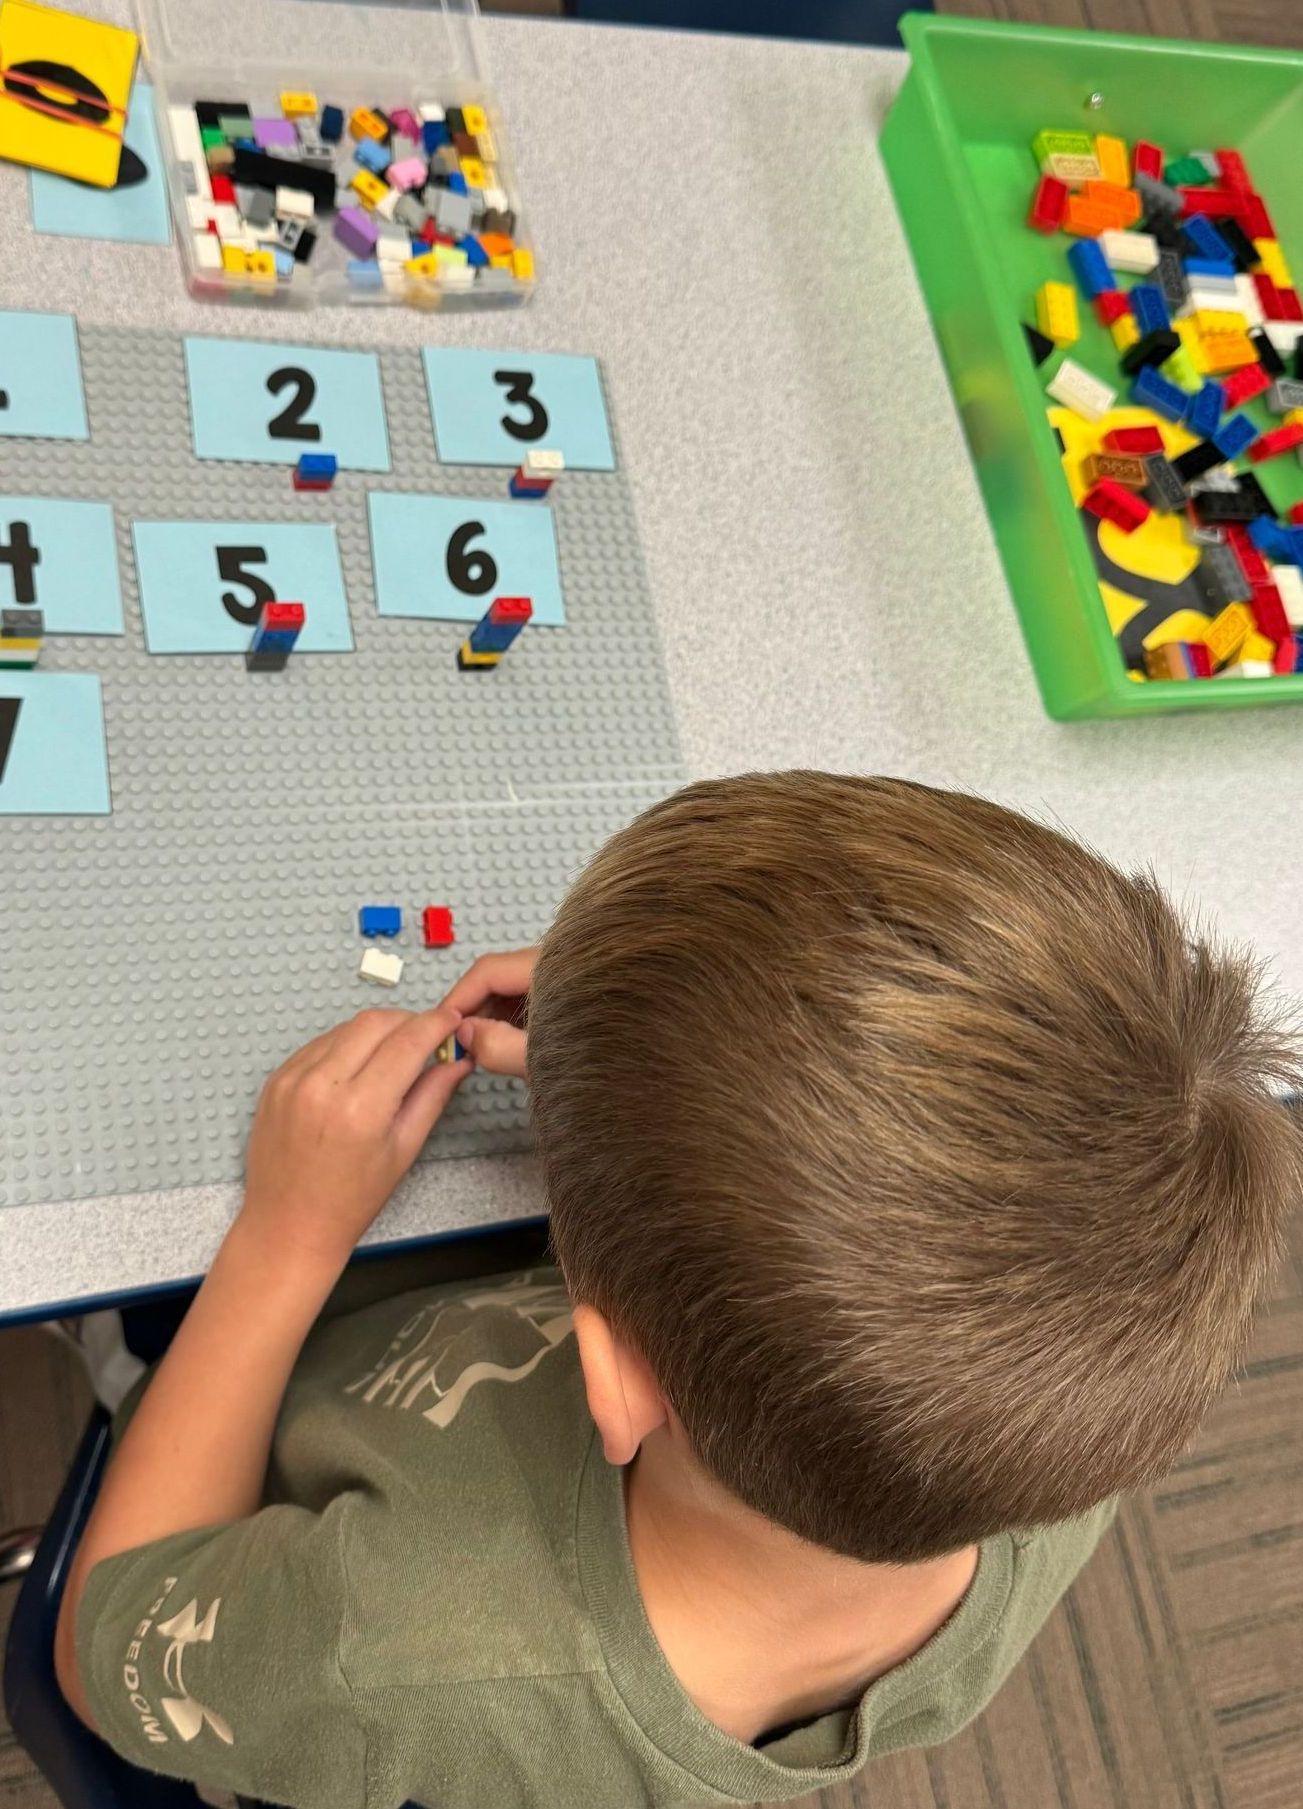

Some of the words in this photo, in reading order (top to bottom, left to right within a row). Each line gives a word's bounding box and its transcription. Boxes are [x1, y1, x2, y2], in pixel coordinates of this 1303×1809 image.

[266, 366, 321, 442] 2
[493, 370, 549, 442] 3
[0, 520, 41, 605] 4
[215, 545, 277, 626] 5
[446, 521, 498, 596] 6
